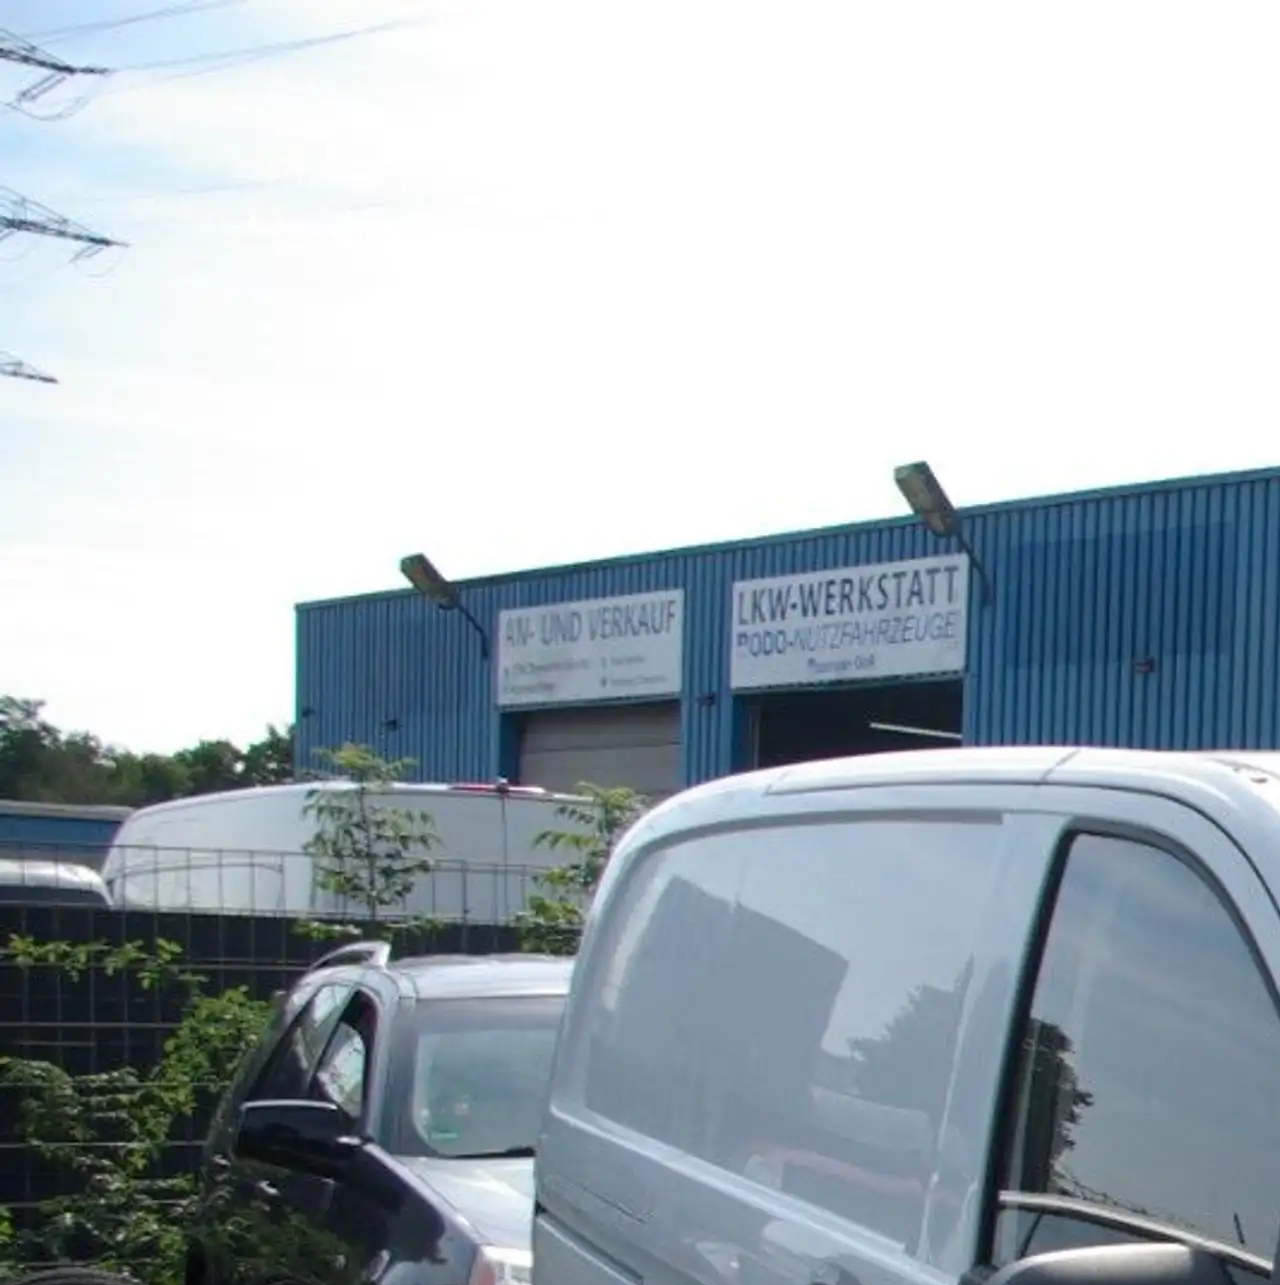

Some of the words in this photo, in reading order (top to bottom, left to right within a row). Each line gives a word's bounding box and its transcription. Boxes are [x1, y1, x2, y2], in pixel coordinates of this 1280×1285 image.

[540, 611, 582, 646] UND
[588, 599, 677, 642] VERKAUF
[738, 565, 959, 626] LKW-WERKSTATT
